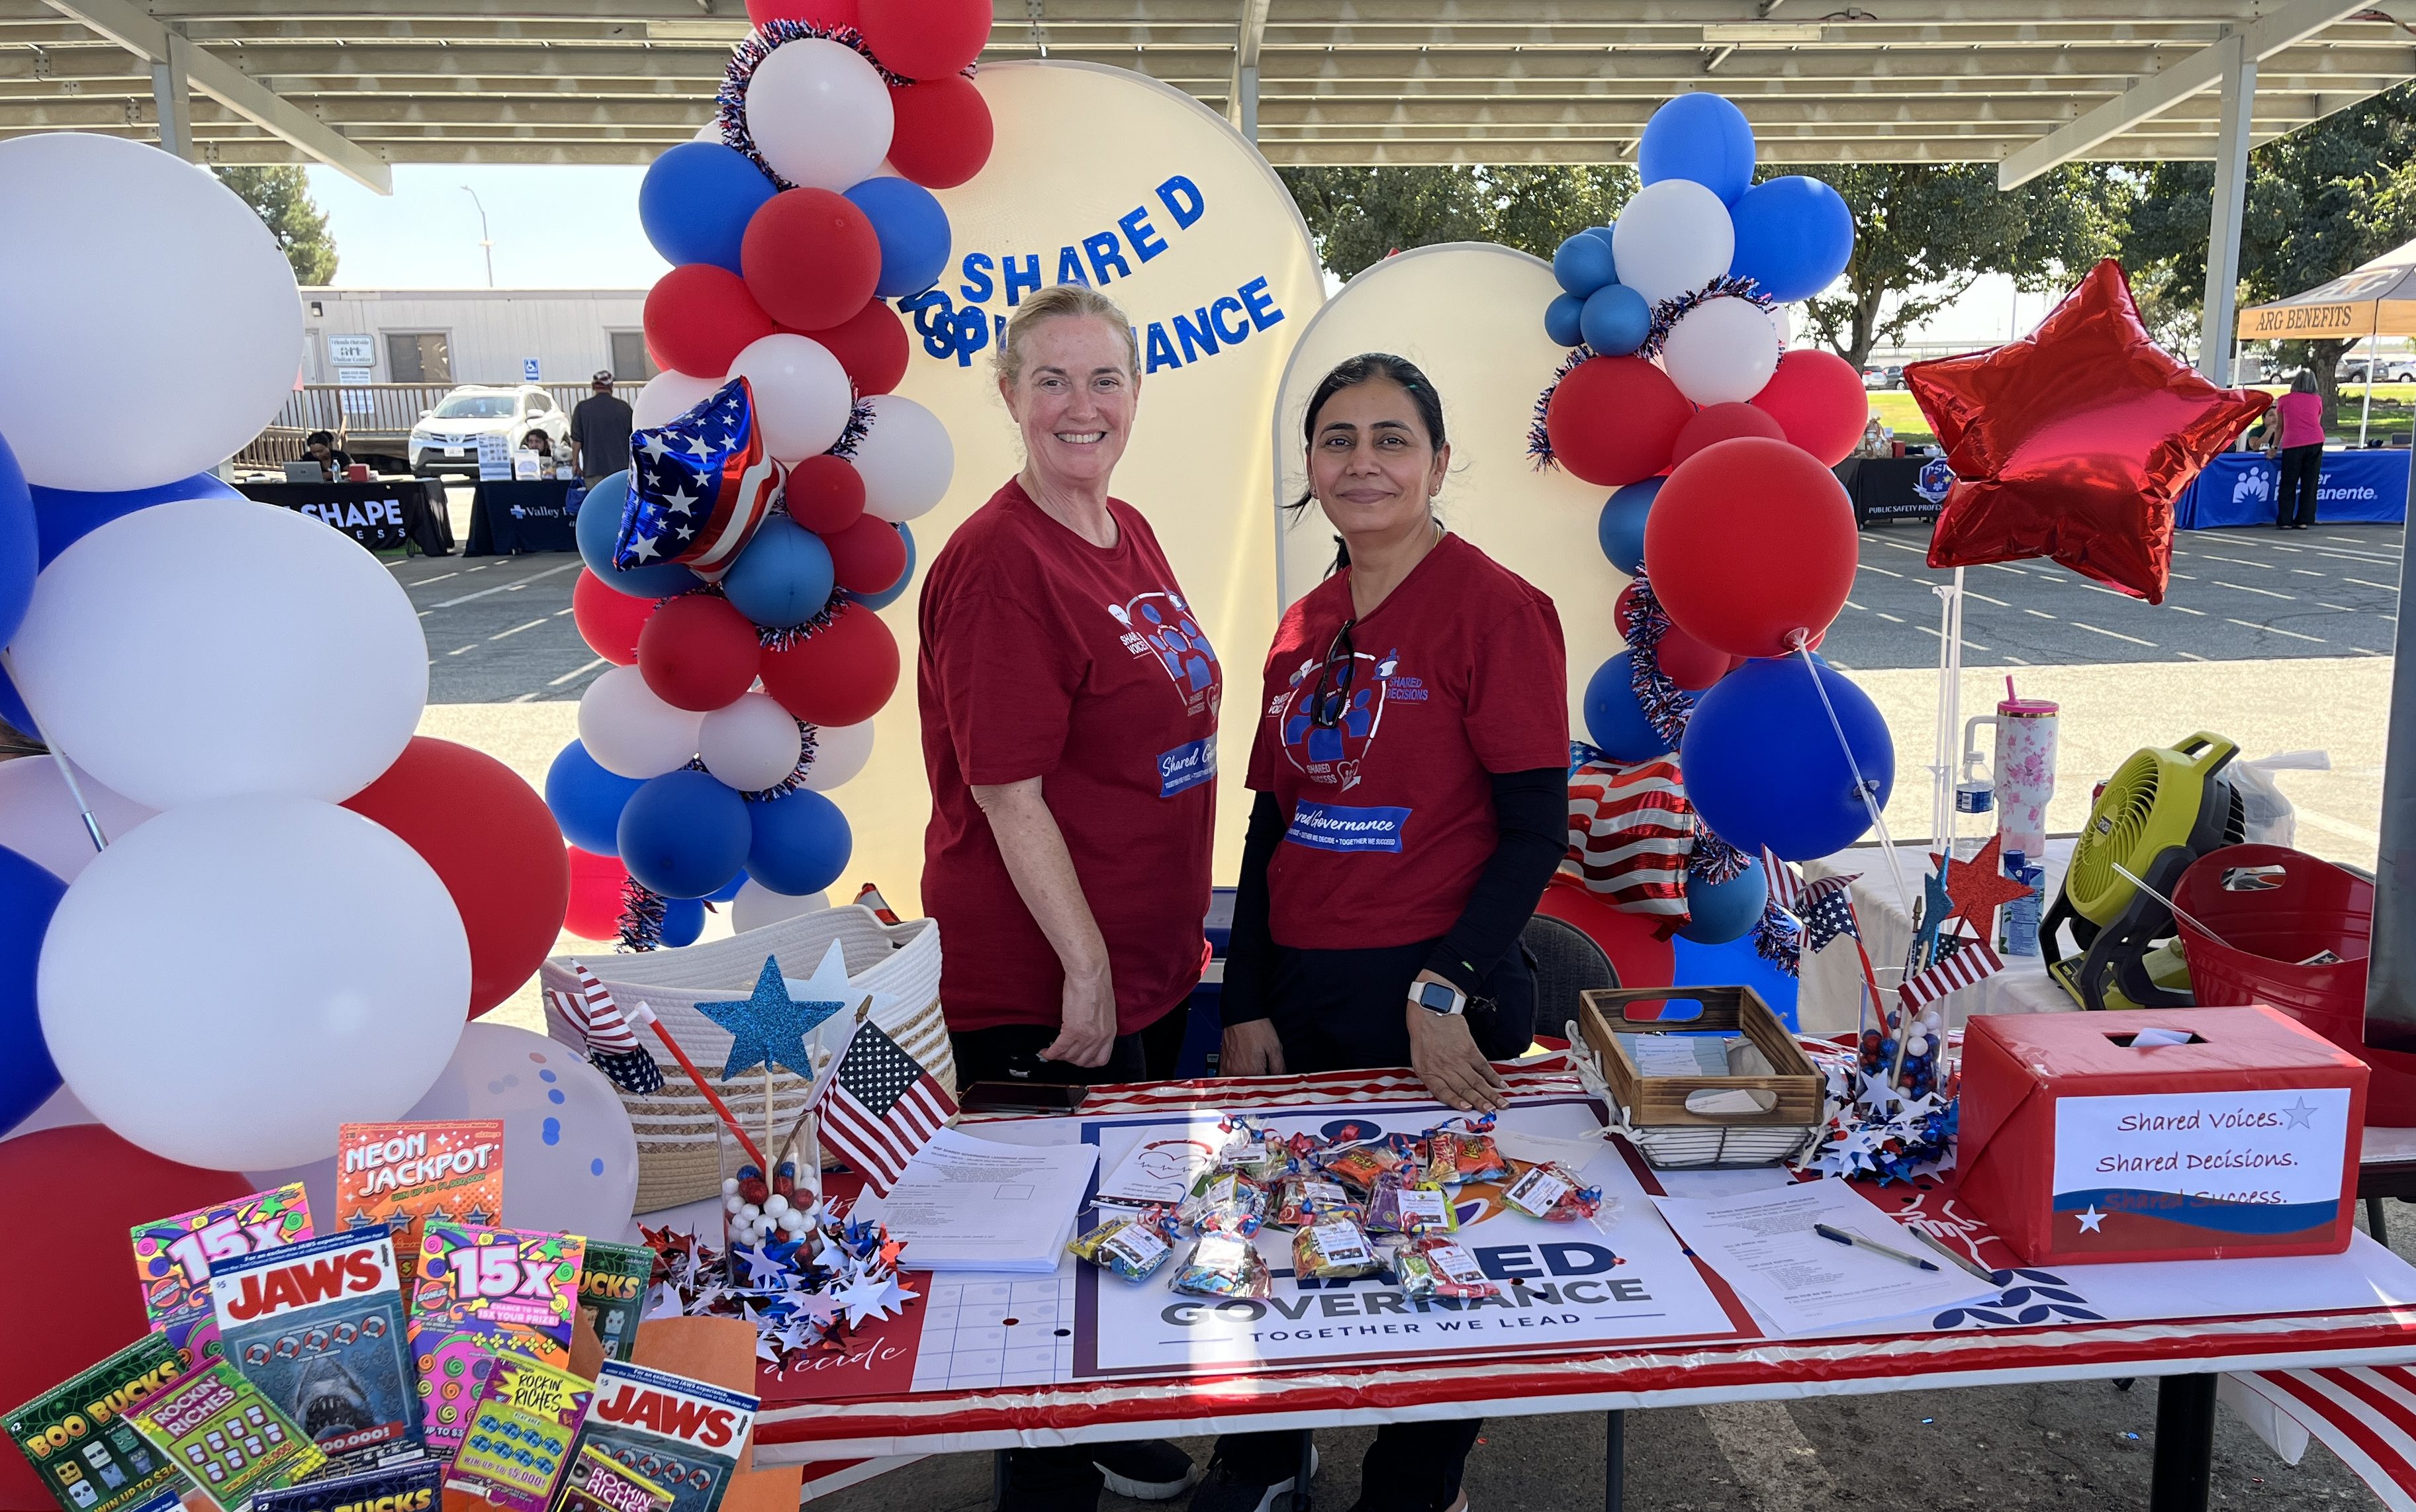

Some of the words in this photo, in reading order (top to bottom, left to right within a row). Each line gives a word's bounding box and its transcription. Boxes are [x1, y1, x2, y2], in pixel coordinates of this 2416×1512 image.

[2255, 311, 2283, 331] ARG
[2286, 306, 2351, 329] BENEFITS
[526, 506, 559, 518] Valley
[1386, 689, 1428, 700] DECISIONS
[1389, 677, 1422, 688] SHARED
[1162, 748, 1199, 777] Shared
[1307, 764, 1330, 774] SHARED
[1311, 810, 1395, 831] Governance
[2117, 1110, 2200, 1132] Shared
[2208, 1108, 2283, 1128] Voices.
[346, 1132, 428, 1174] NEON
[2096, 1151, 2178, 1173] Shared
[2187, 1149, 2298, 1169] Decisions.
[358, 1143, 494, 1197] JACKPOT
[2101, 1189, 2183, 1210] Shared
[2191, 1189, 2287, 1206] Success.
[227, 1249, 382, 1320] JAWS
[418, 1288, 447, 1302] BONUS
[578, 1271, 640, 1299] UCKS
[478, 1310, 495, 1319] 15X
[497, 1312, 525, 1321] YOUR
[526, 1314, 559, 1324] PRIZE!
[1249, 1323, 1420, 1342] TOGETHER
[1436, 1320, 1483, 1332] WE
[1499, 1313, 1580, 1328] LEAD
[518, 1375, 563, 1392] ROCKIN'
[652, 1374, 679, 1385] exclusive
[678, 1380, 695, 1389] JAWS
[695, 1385, 728, 1398] experience,
[26, 1415, 87, 1457] BOO
[87, 1360, 181, 1423] BUCKS
[153, 1374, 220, 1423] ROCKIN'
[514, 1389, 563, 1412] RICHES
[5, 1412, 19, 1421] Enter
[167, 1386, 236, 1437] RICHES
[598, 1384, 736, 1447] JAWS
[320, 1427, 390, 1452] 00,000!
[435, 1427, 448, 1436] TO
[464, 1456, 480, 1466] WIN
[482, 1460, 494, 1470] UP
[496, 1465, 506, 1474] TO
[508, 1468, 546, 1487] $5,000!
[93, 1497, 119, 1512] WIN
[120, 1487, 136, 1501] UP
[136, 1478, 153, 1490] TO
[154, 1462, 179, 1482] $30
[592, 1467, 655, 1508] ROCKIN'
